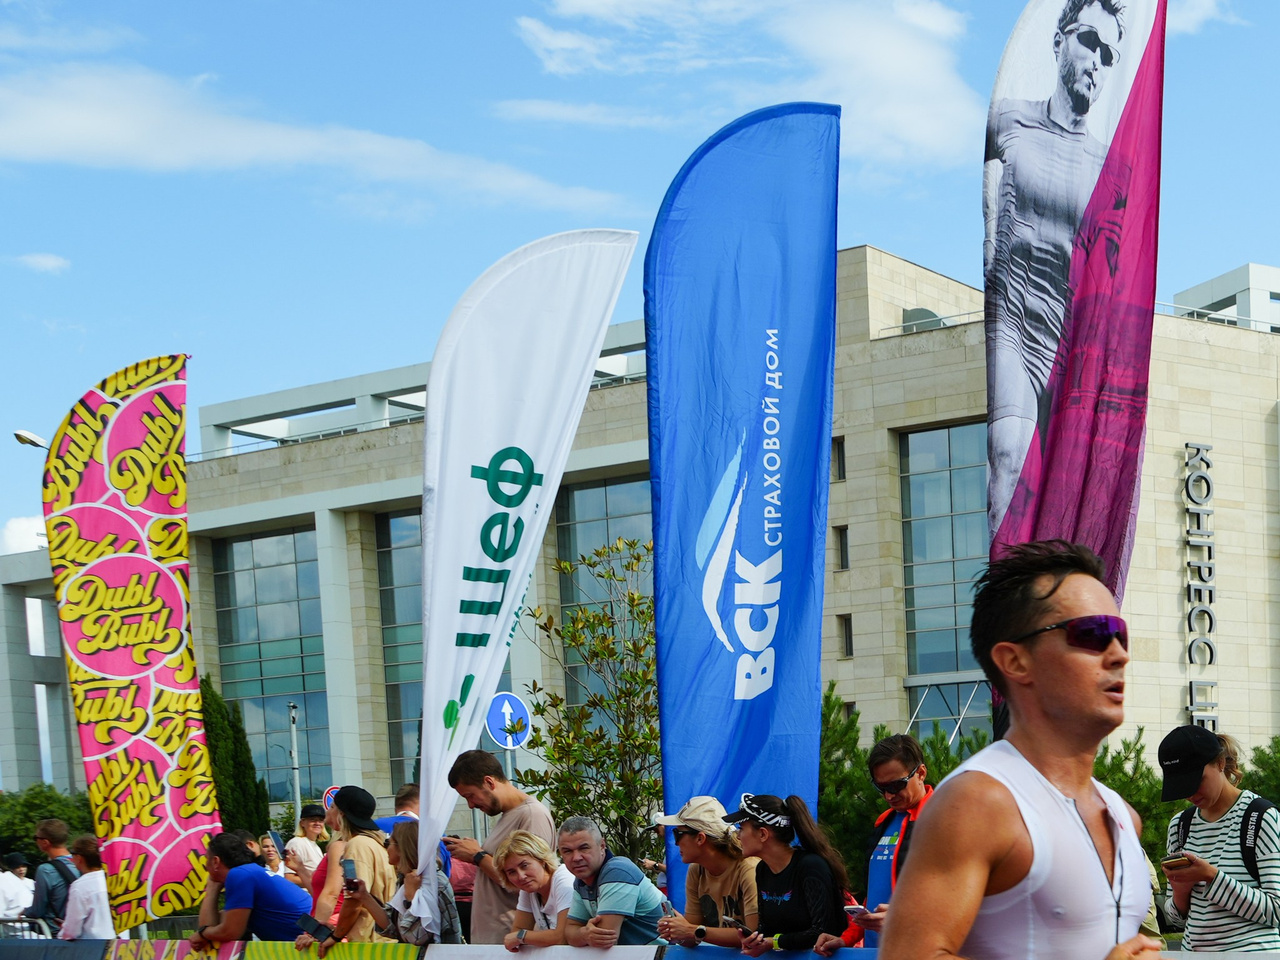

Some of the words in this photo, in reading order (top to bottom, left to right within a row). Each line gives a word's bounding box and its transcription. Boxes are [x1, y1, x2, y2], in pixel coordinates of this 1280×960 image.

[765, 328, 783, 389] ДОМ
[762, 396, 784, 547] СТРАХОВОЙ
[59, 571, 164, 623] Dubl
[455, 446, 544, 648] Шеф
[1185, 442, 1217, 665] КОНГРЕСС
[77, 607, 184, 665] Bubl
[734, 549, 782, 700] ВСК
[1246, 811, 1259, 848] IRONSTAR
